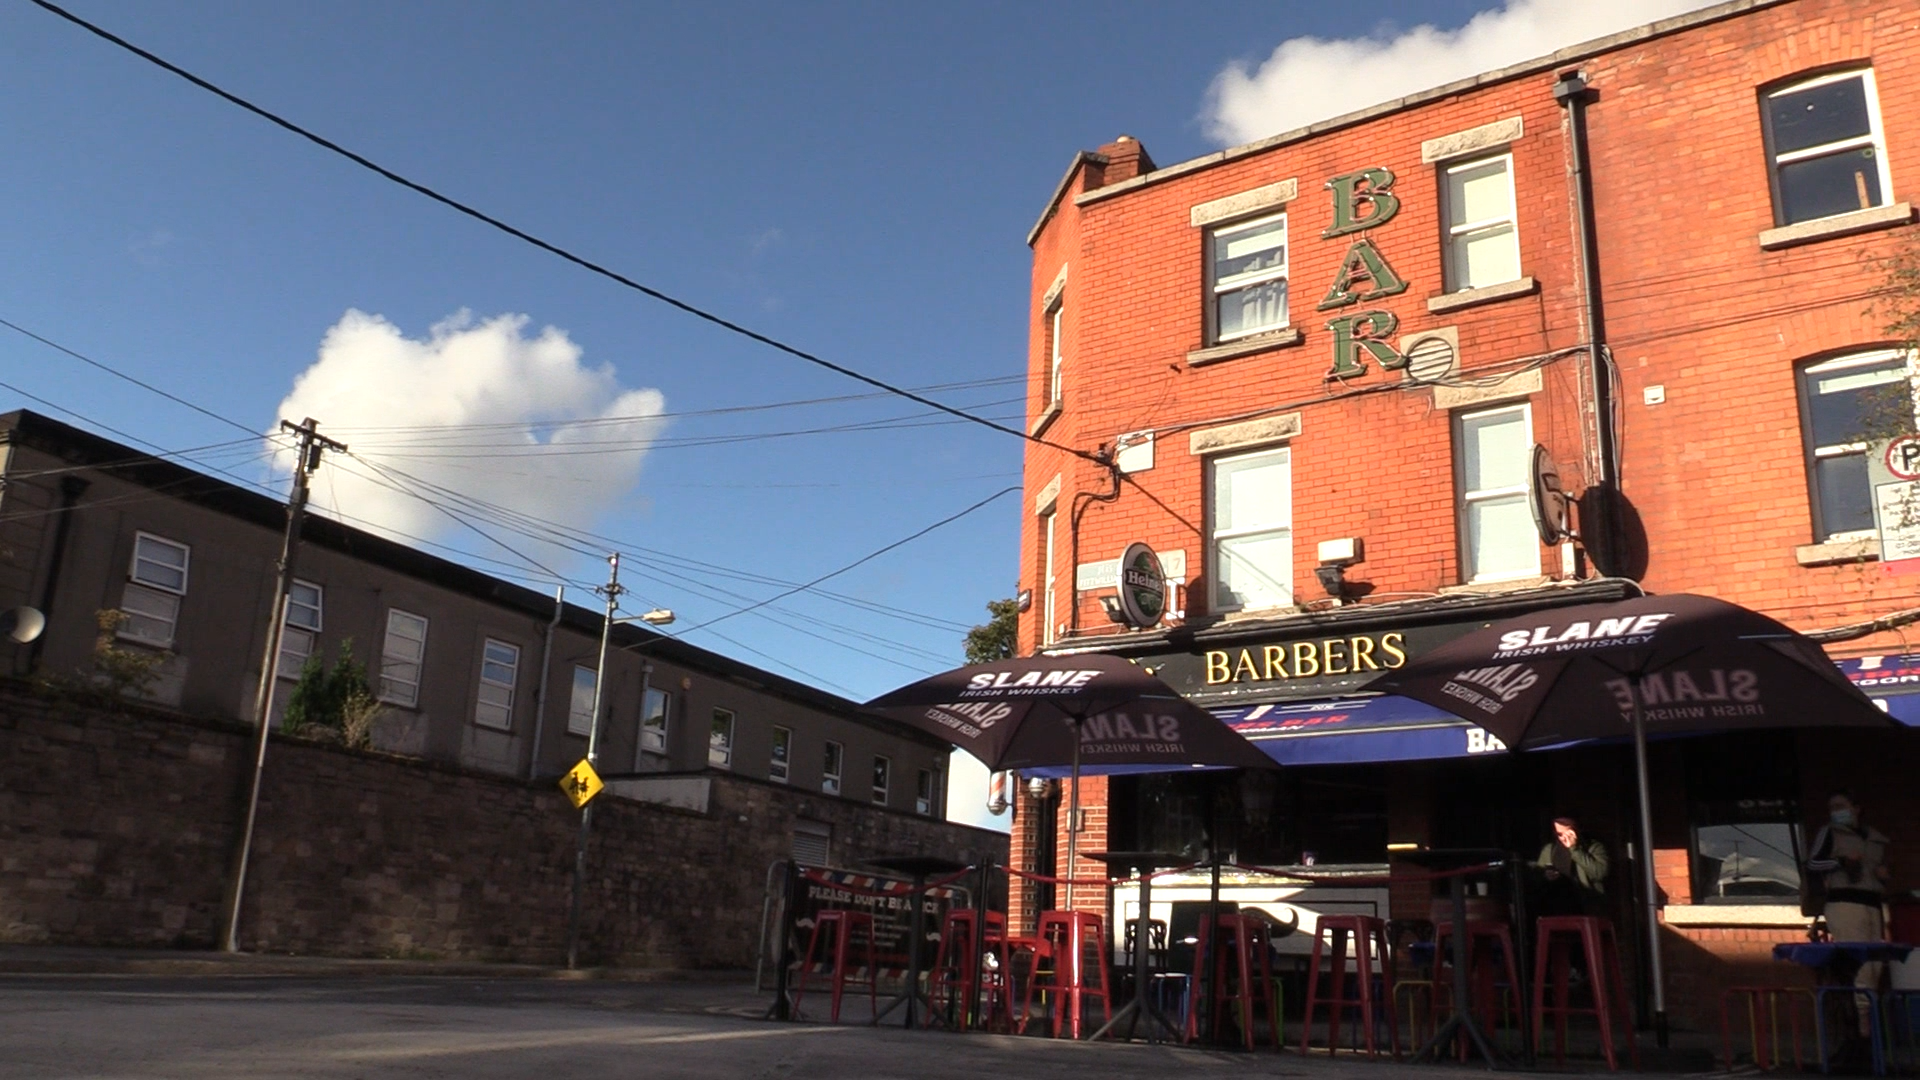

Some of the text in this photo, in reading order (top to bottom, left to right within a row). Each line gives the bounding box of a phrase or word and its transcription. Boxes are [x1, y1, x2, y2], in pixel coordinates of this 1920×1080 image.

[1317, 166, 1410, 382] BAR
[1498, 613, 1675, 651] SLANE
[1204, 632, 1408, 686] BARBERS
[1492, 635, 1654, 660] IRISH WHISKEY
[967, 669, 1105, 690] SLANE
[958, 687, 1083, 698] IRISH WHISKEY
[808, 885, 851, 903] PLEASE
[903, 898, 912, 910] A
